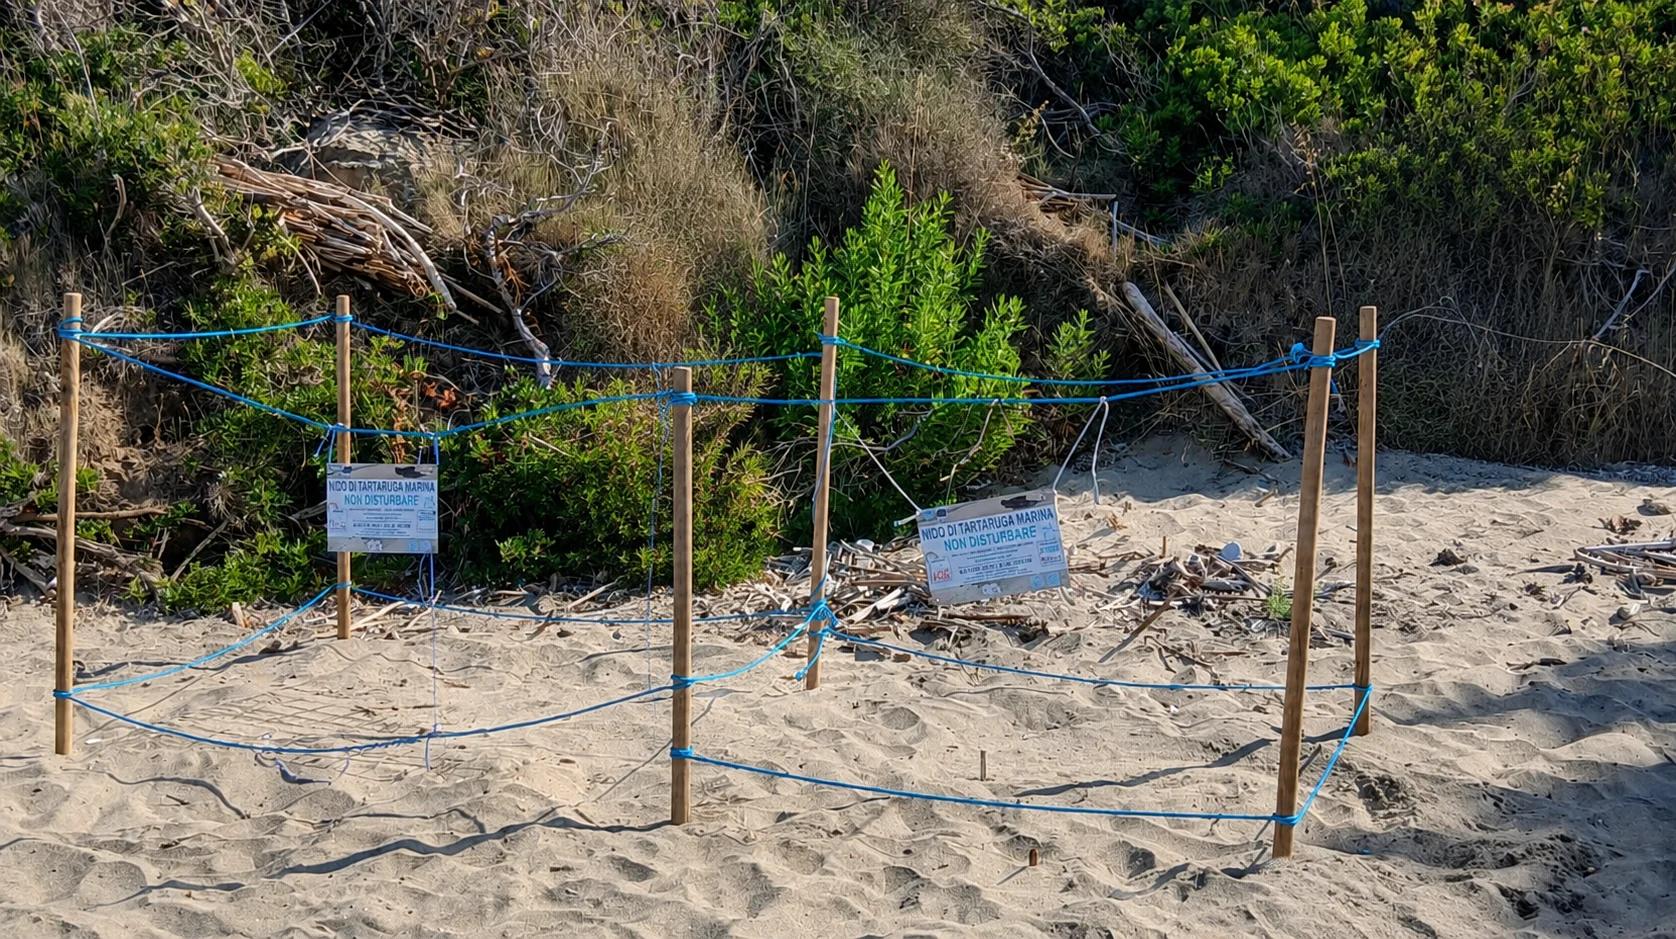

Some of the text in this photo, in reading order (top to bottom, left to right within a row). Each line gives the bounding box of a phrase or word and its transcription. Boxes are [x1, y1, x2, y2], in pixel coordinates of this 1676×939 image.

[349, 481, 357, 492] DI
[358, 481, 404, 492] TARTARUGA
[405, 482, 435, 493] MARINA
[344, 495, 419, 506] NON DISTURBARE
[921, 508, 1054, 541] NIDO DI TARTARUGA MARINA
[944, 538, 967, 551] NON
[969, 526, 1037, 547] DISTURBARE
